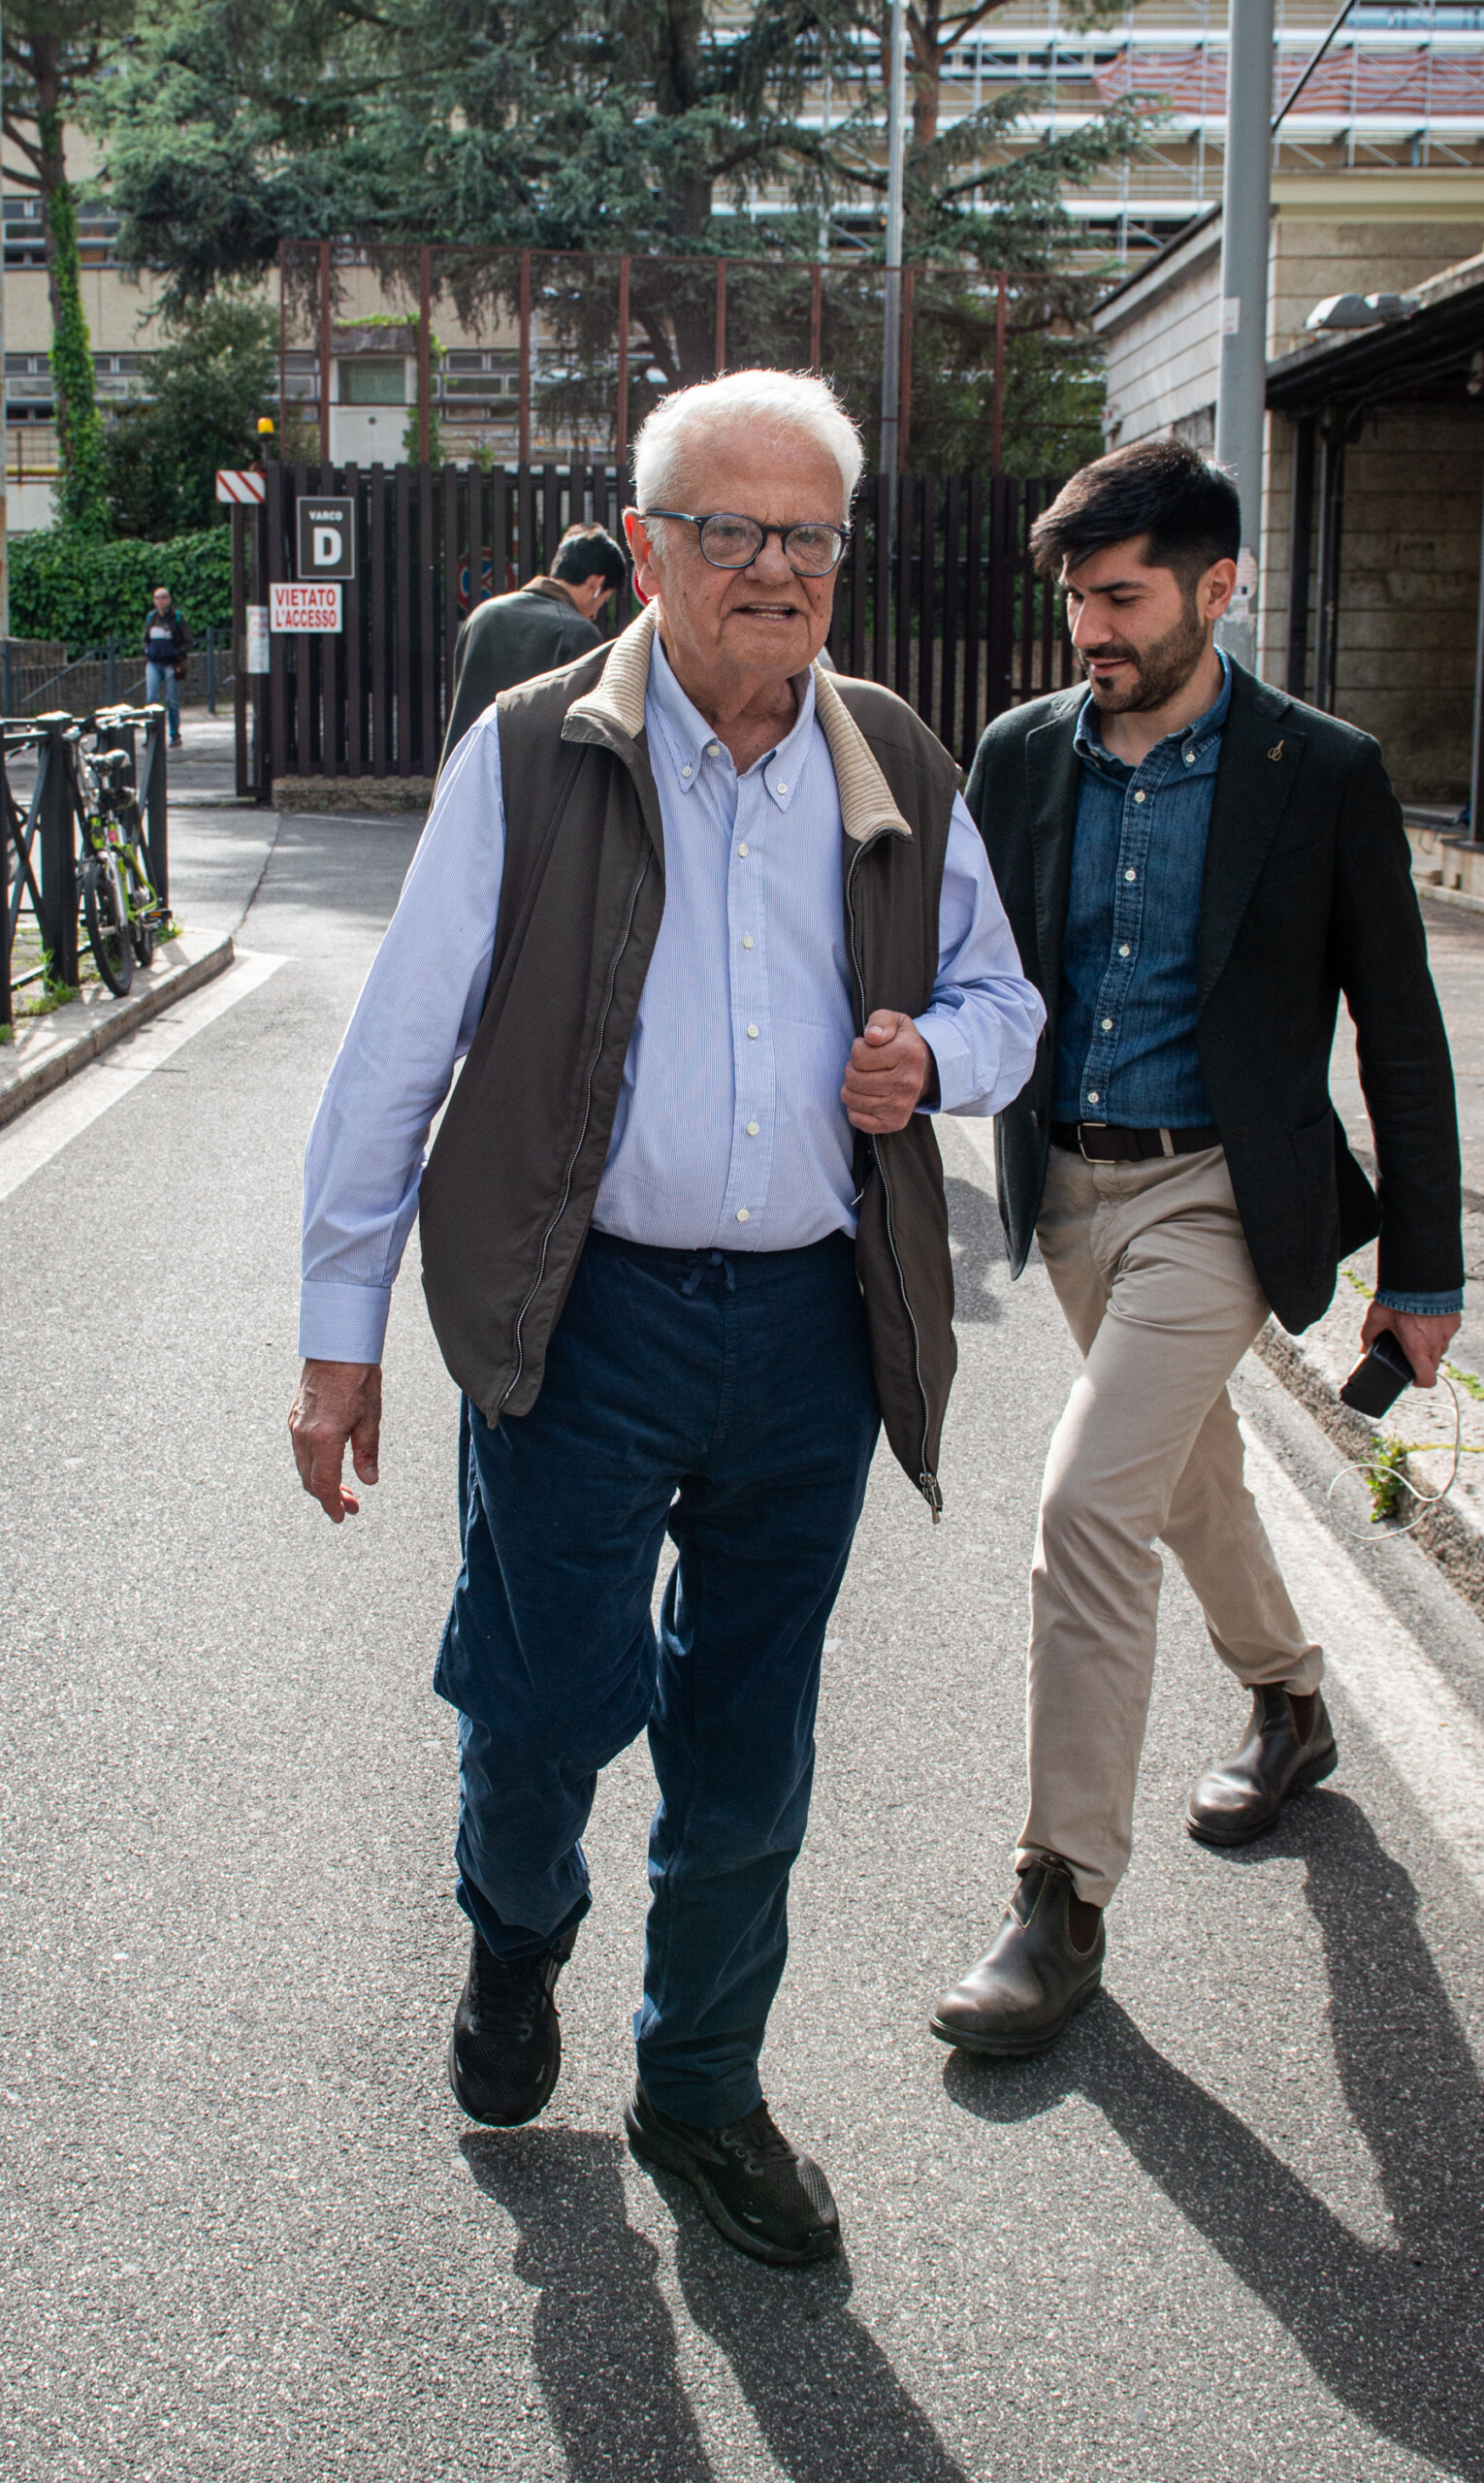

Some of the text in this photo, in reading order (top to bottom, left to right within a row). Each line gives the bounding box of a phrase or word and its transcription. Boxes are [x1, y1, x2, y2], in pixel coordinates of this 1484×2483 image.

[308, 510, 343, 521] VARCO
[313, 527, 342, 565] D
[274, 588, 337, 606] VIETATO
[275, 609, 338, 628] L'ACCESSO
